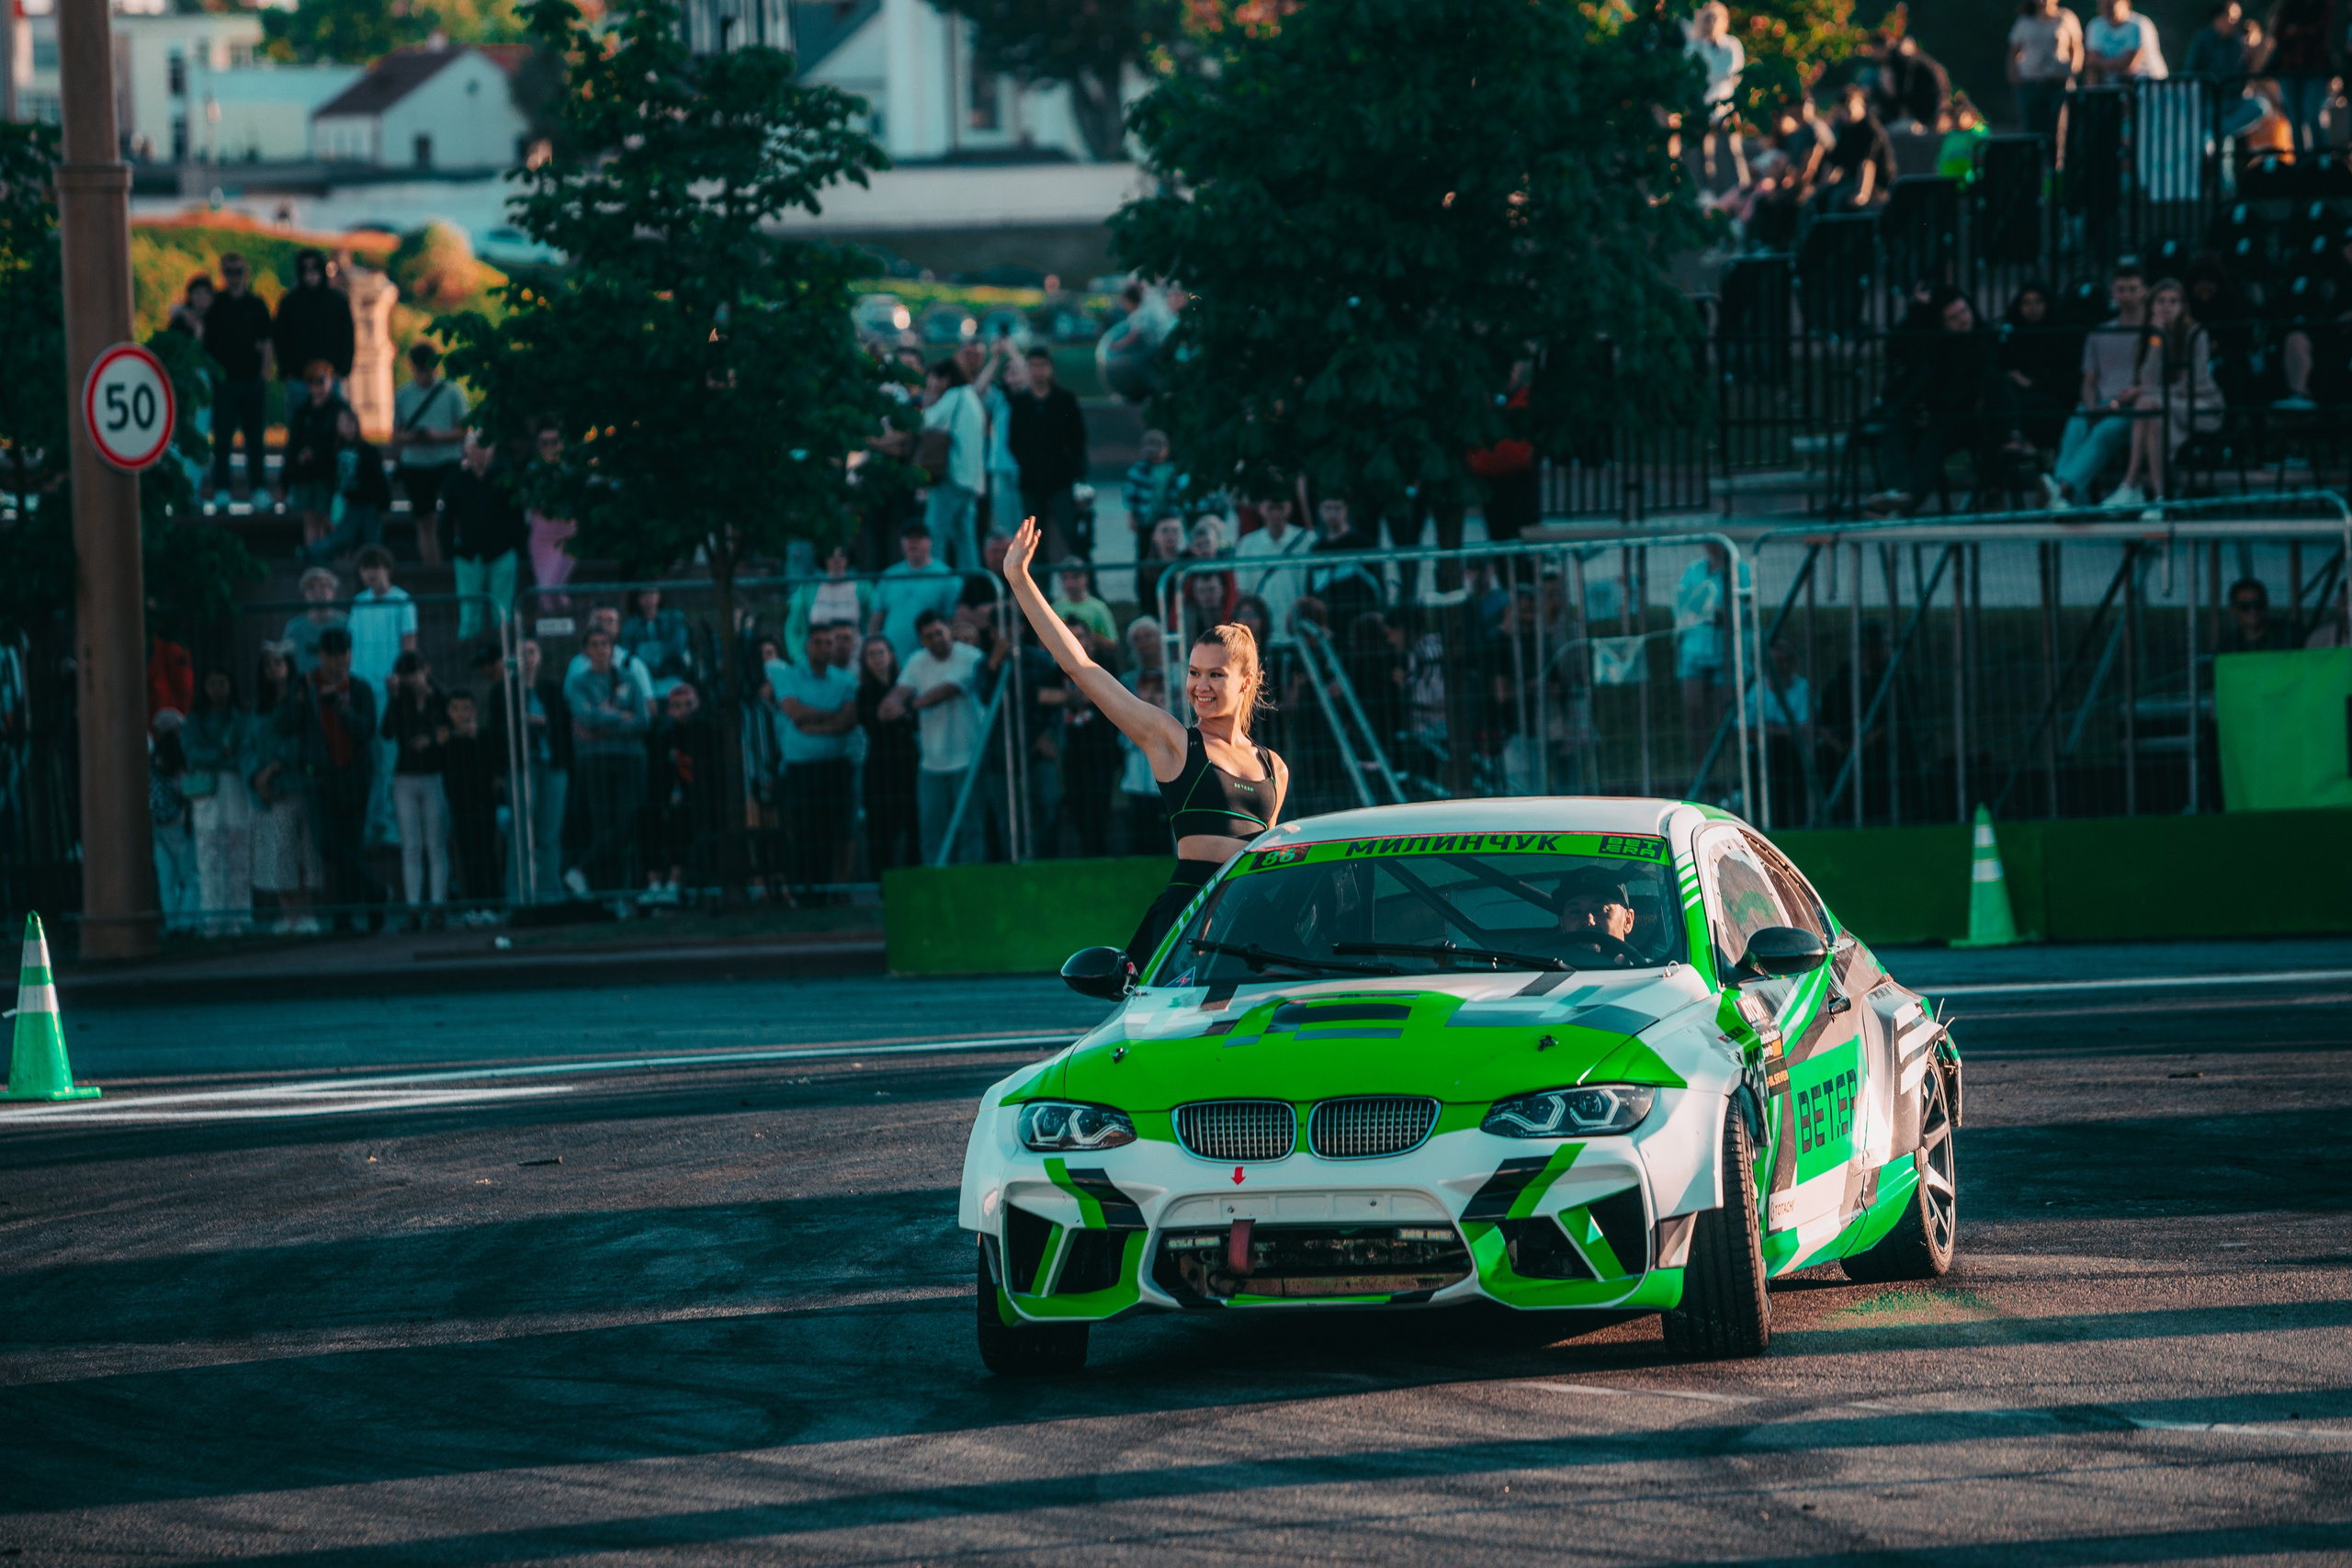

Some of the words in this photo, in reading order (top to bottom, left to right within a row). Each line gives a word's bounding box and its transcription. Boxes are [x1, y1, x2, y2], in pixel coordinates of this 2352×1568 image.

[106, 382, 155, 431] 50
[1345, 835, 1562, 856] МИЛИНЧУК
[1608, 837, 1658, 850] BET
[1261, 846, 1296, 866] 86
